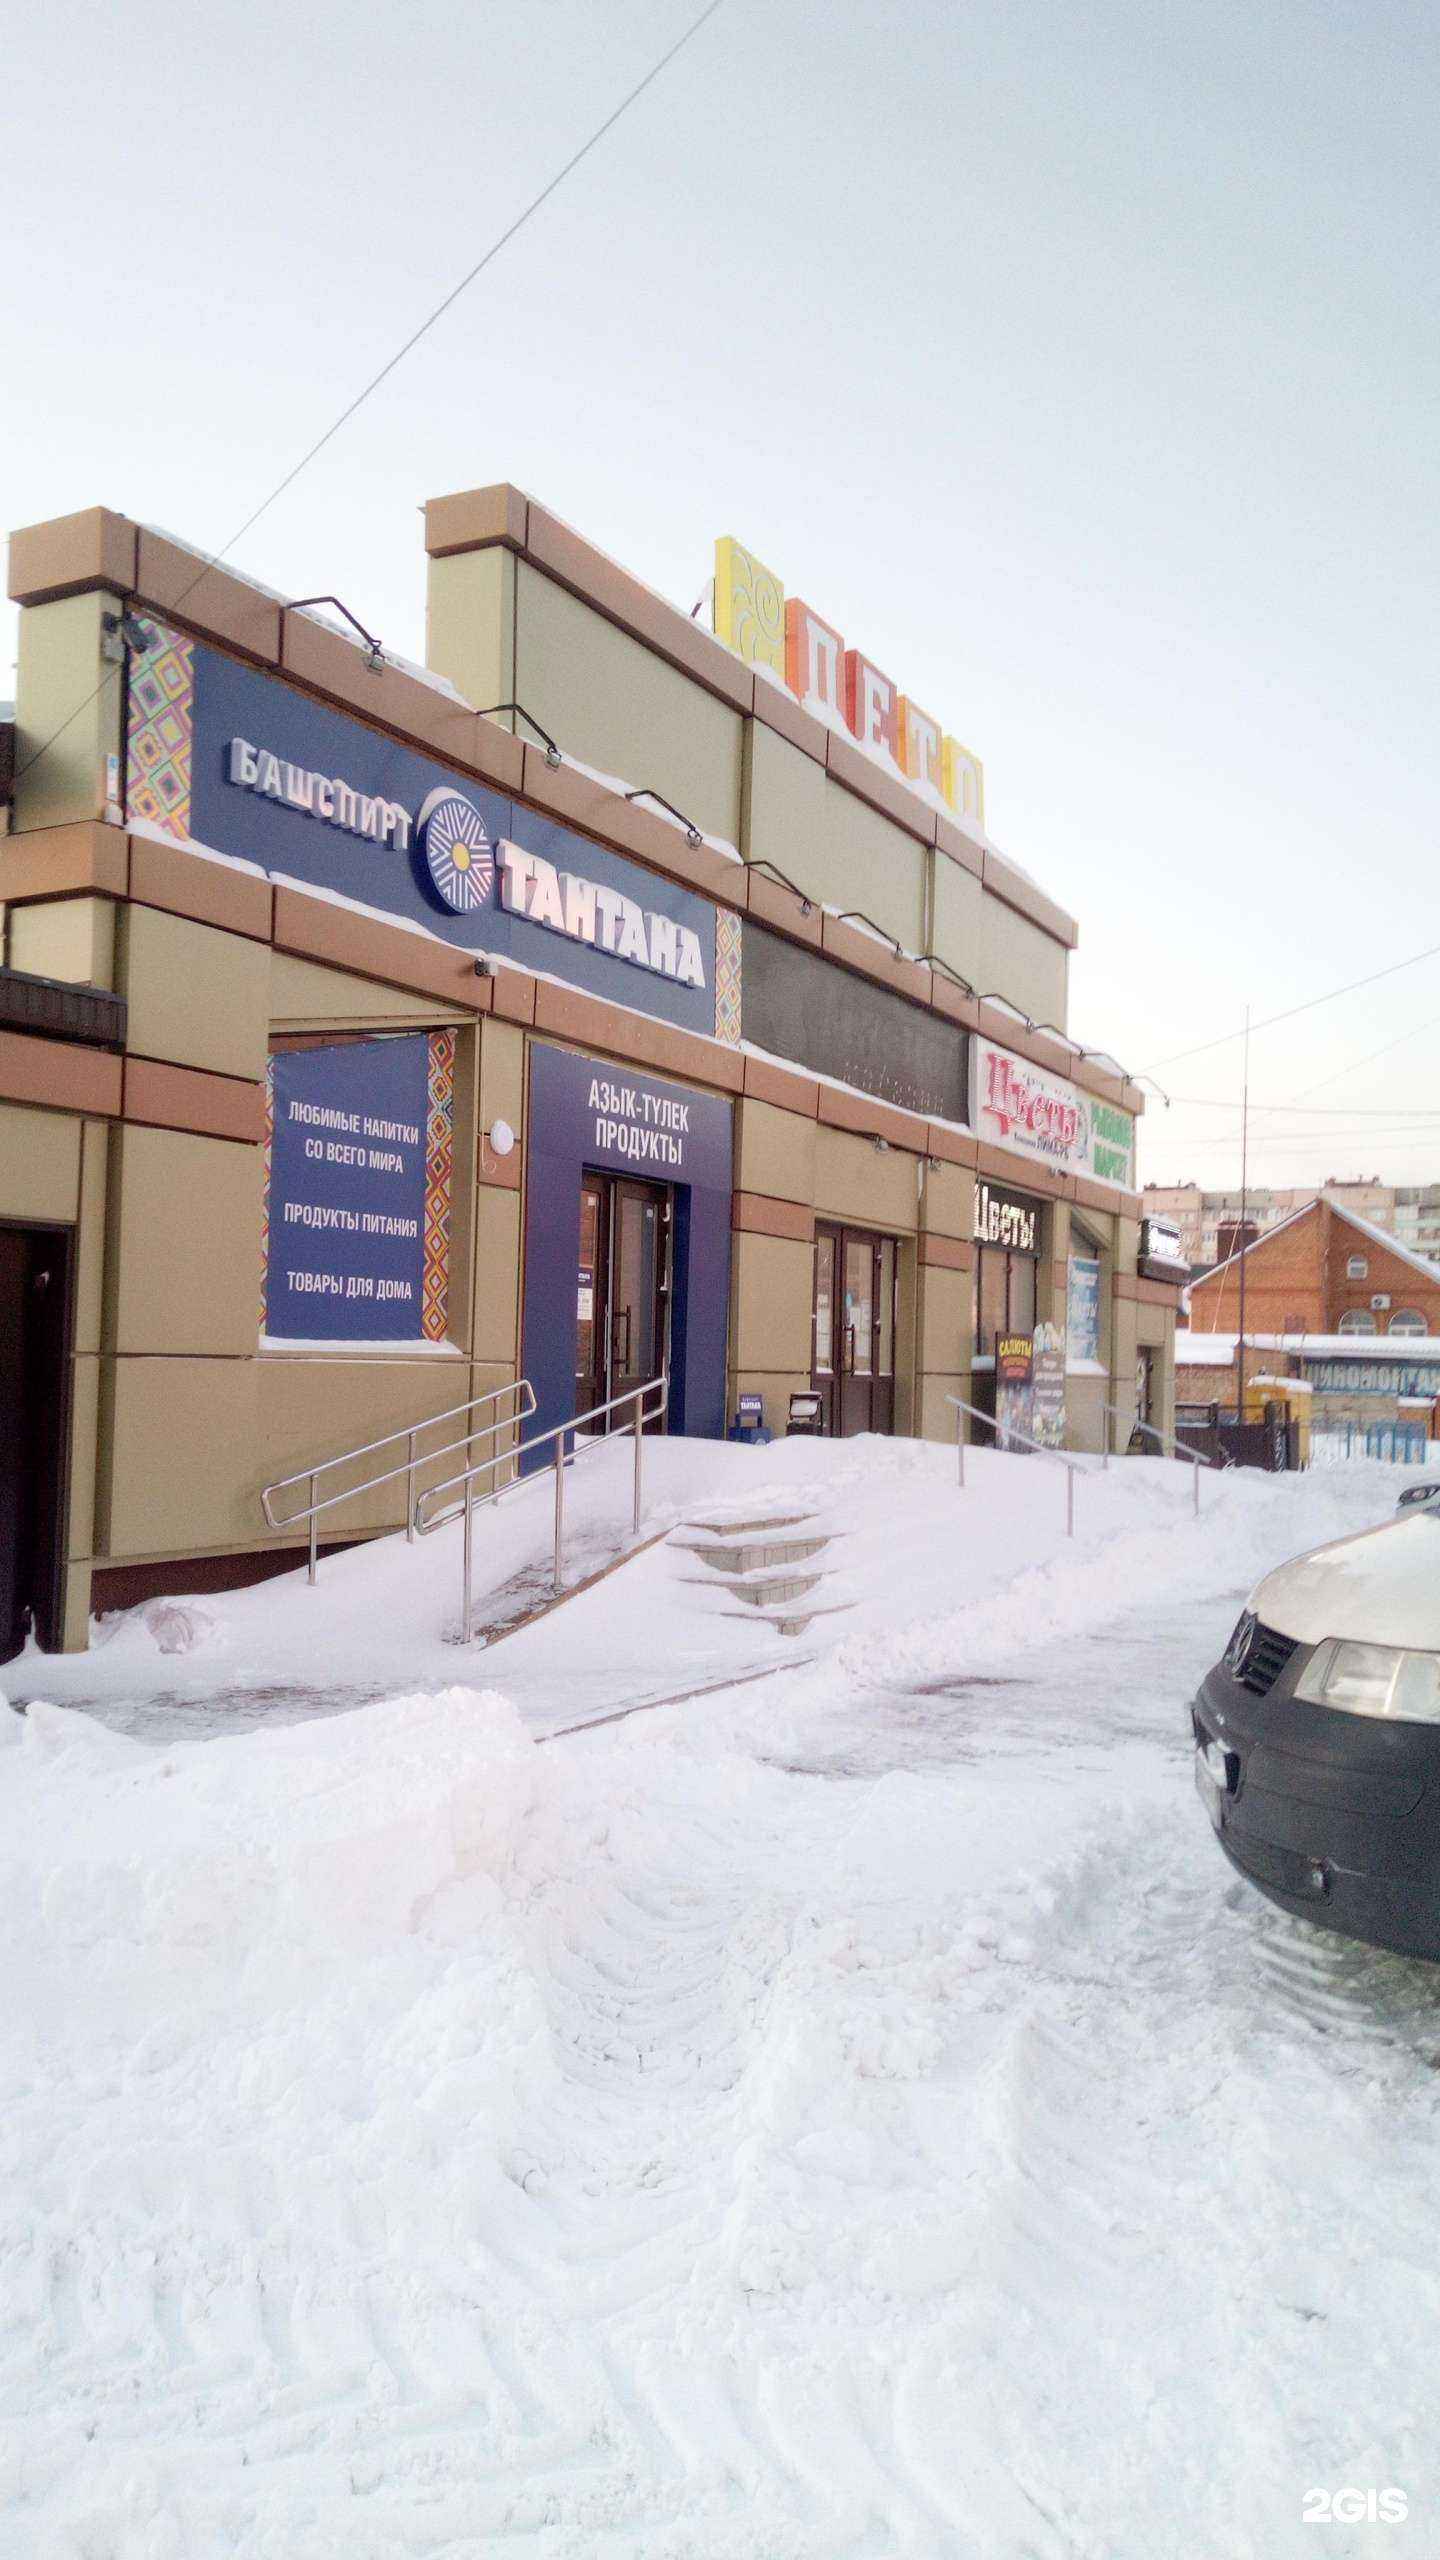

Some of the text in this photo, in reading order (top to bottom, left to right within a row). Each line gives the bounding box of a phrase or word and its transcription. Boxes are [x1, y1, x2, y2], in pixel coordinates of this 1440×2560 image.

[231, 737, 413, 850] БАШСПИРТ
[497, 838, 706, 989] ТАНТАНА
[288, 1101, 419, 1144] ЛЮБИМЫЕ НАПИТКИ
[595, 1118, 682, 1165] ПРОДУКТЫ
[305, 1138, 404, 1174] СО ВСЕГО МИРА
[284, 1203, 418, 1238] ПРОДУКТЫ ПИТАНИЯ
[286, 1271, 412, 1300] ТОВАРЫ ДЛЯ ДОМА
